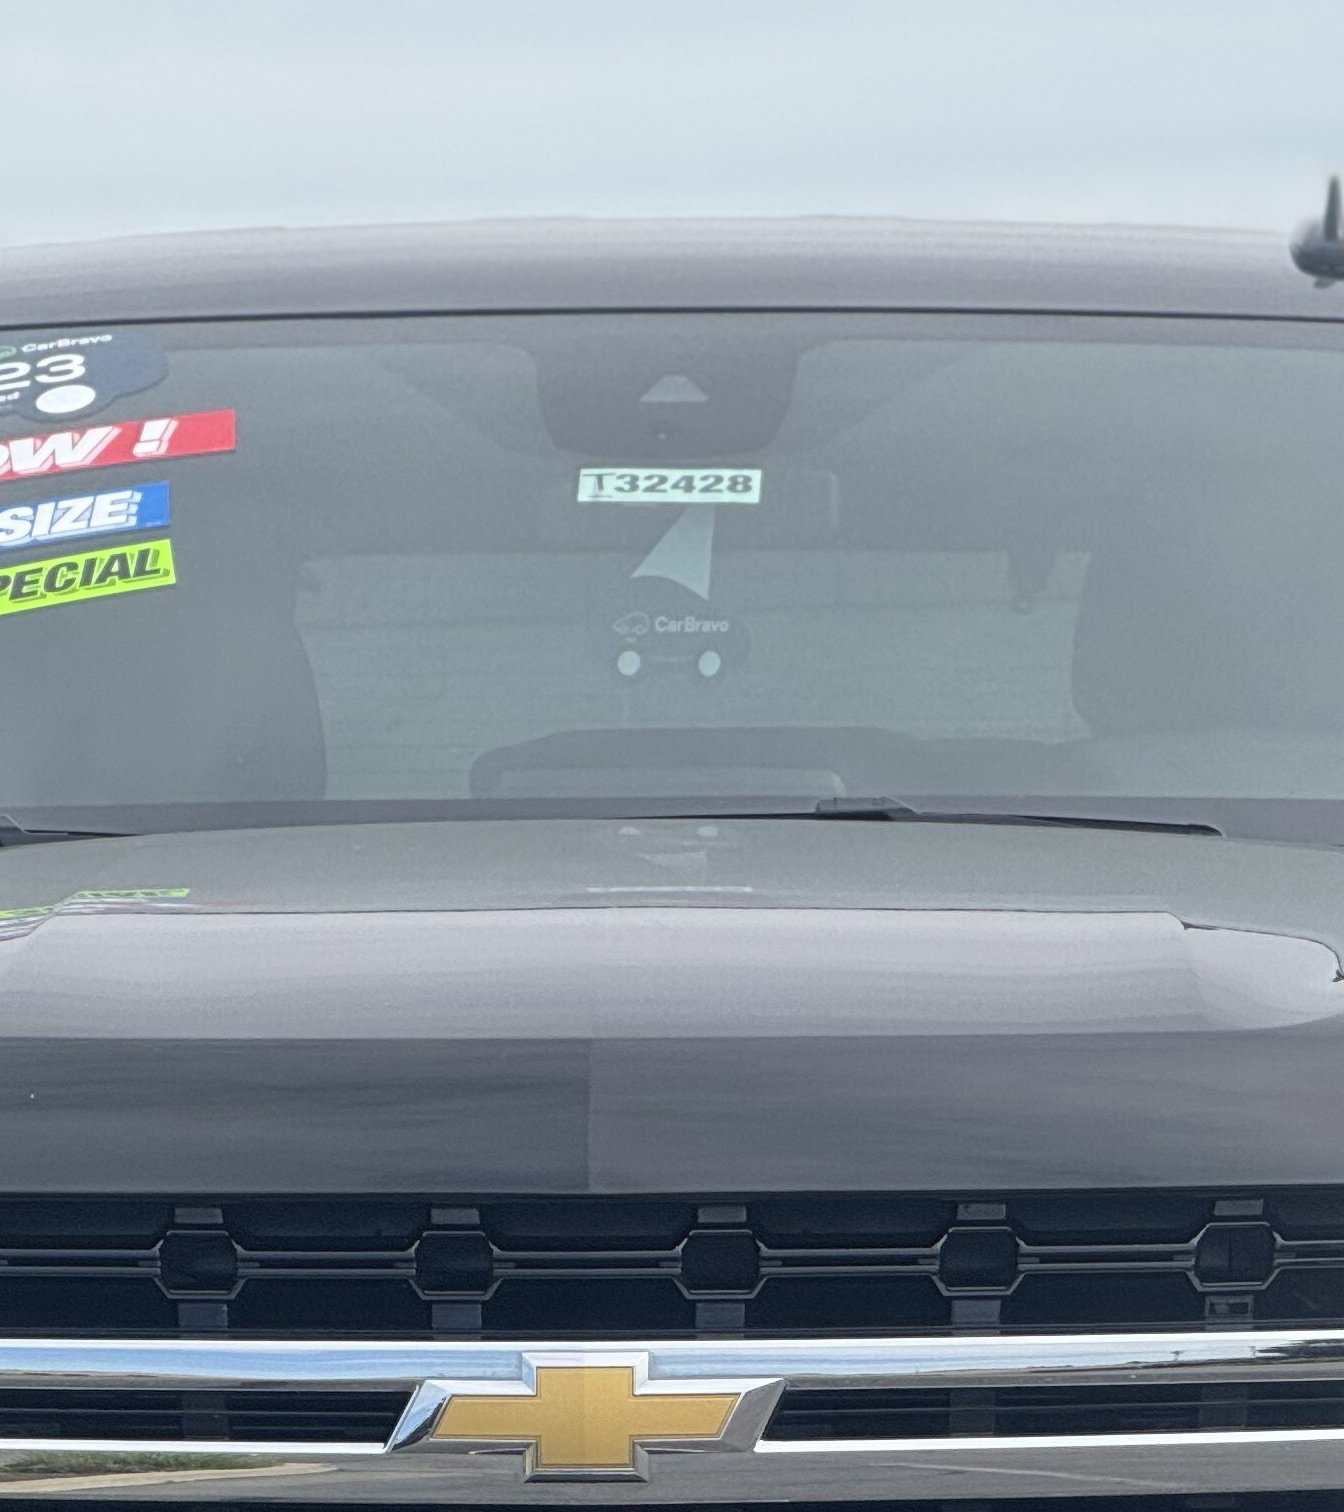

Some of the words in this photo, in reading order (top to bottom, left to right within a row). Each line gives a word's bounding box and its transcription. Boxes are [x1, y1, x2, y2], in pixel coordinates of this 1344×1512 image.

[21, 334, 113, 352] CarBravo
[582, 473, 754, 498] T32428
[654, 615, 730, 634] CarBravo
